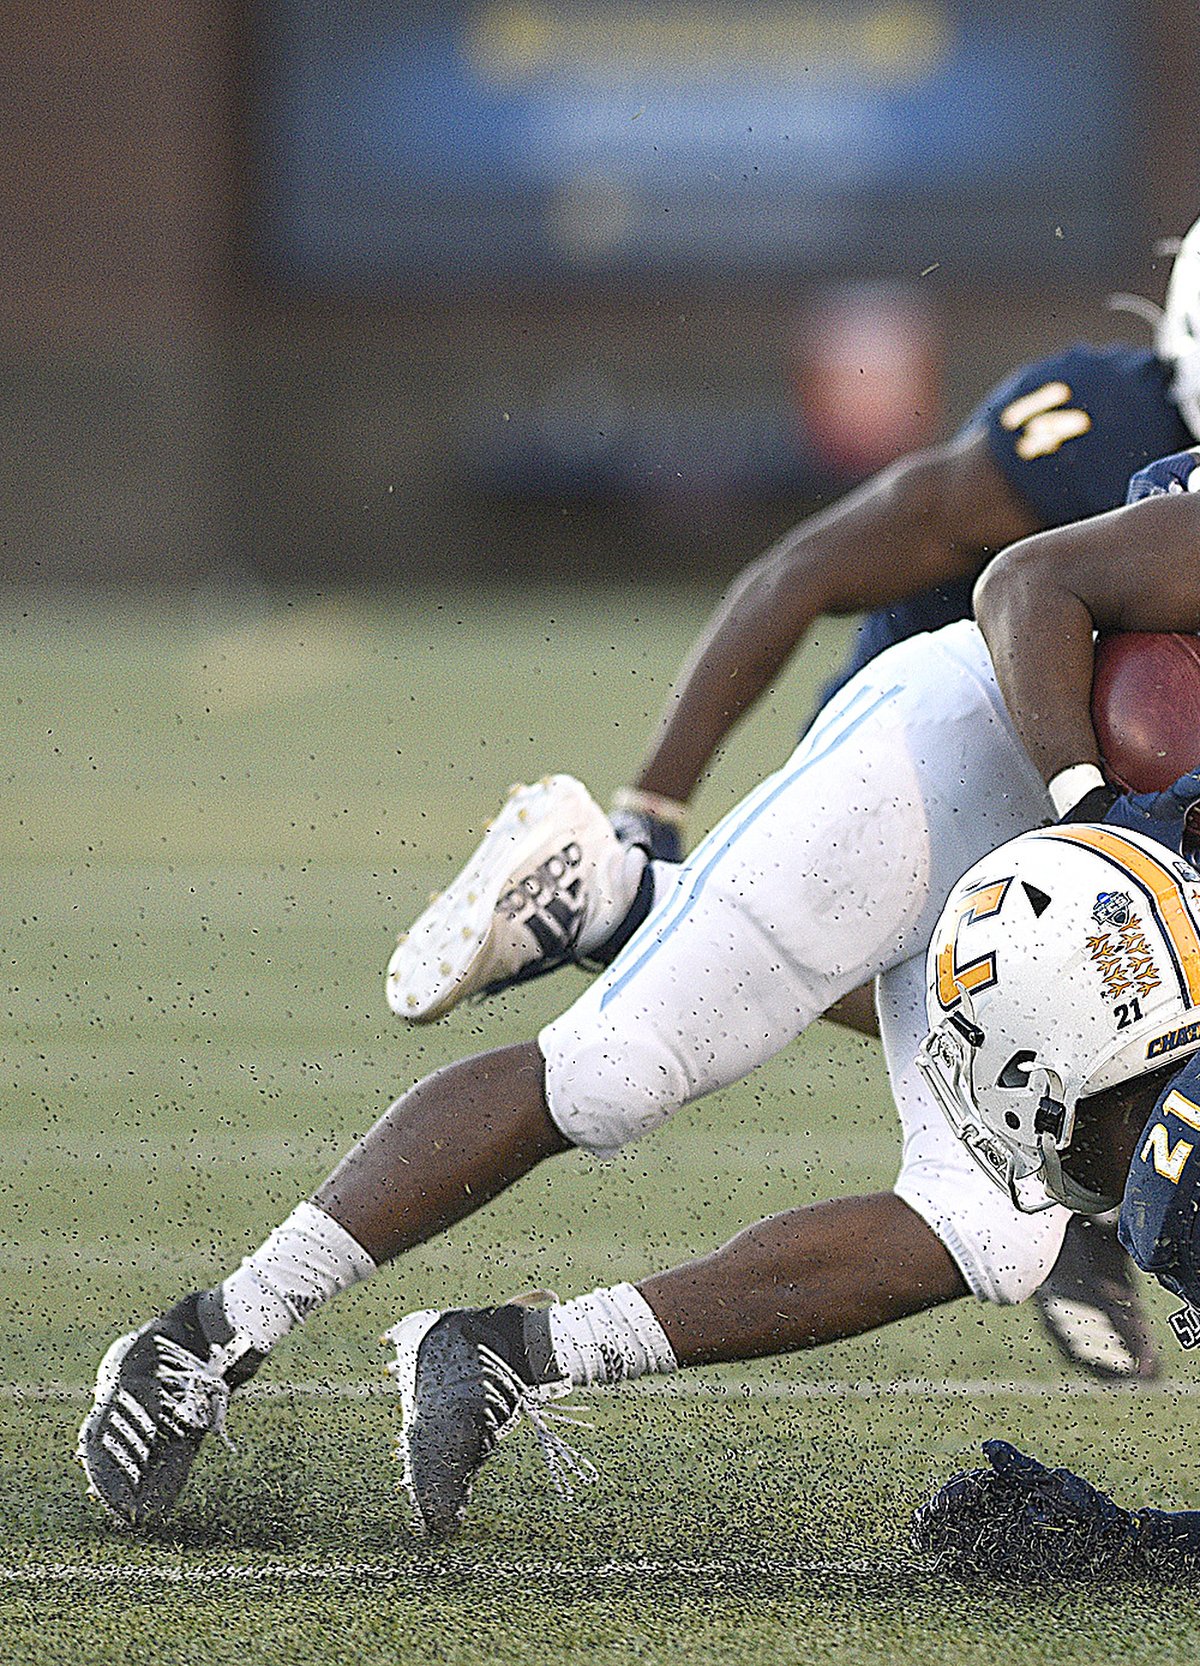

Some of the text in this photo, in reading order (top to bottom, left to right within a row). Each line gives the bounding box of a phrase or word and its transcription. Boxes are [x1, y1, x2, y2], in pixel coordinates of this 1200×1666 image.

[1000, 381, 1091, 461] 14
[495, 842, 582, 915] adidas
[935, 876, 1015, 1012] C
[1113, 997, 1144, 1030] 21
